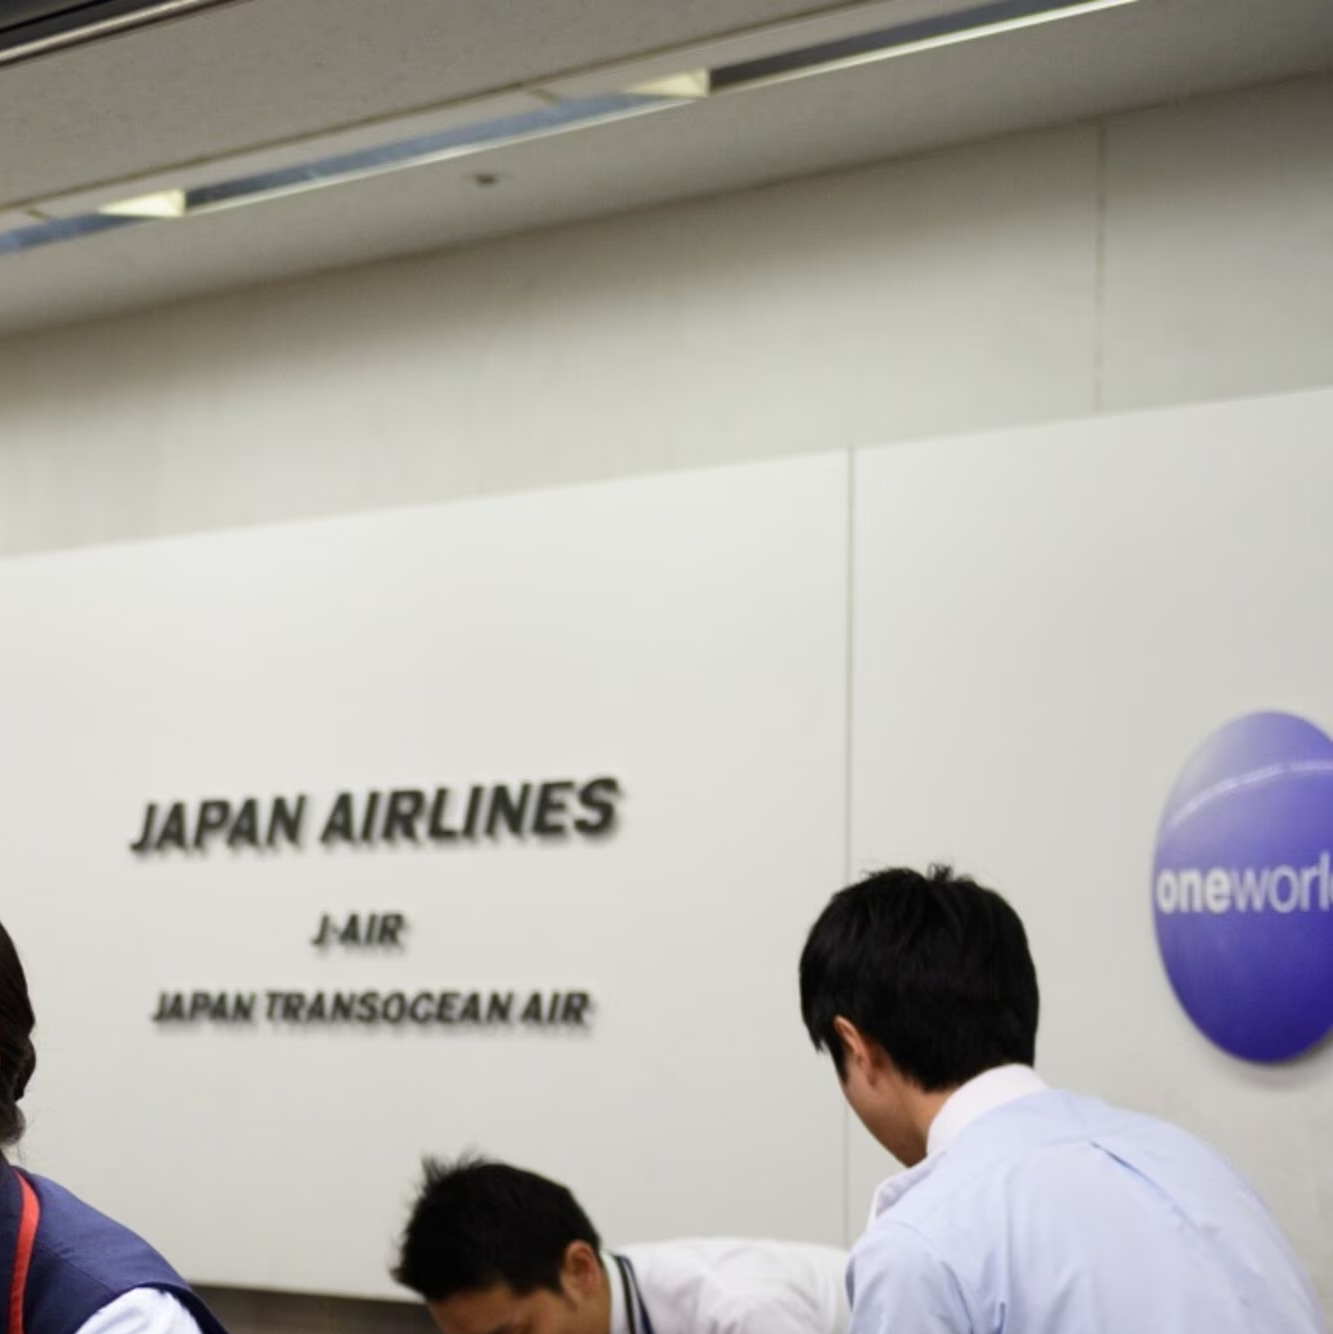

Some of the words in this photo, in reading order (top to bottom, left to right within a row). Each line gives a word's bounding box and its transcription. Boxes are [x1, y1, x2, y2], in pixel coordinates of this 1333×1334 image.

[131, 791, 303, 855] JAPAN
[319, 775, 622, 844] AIRLINES
[151, 991, 256, 1028] JAPAN
[264, 990, 511, 1027] TRANSOCEAN
[522, 989, 593, 1026] AIR
